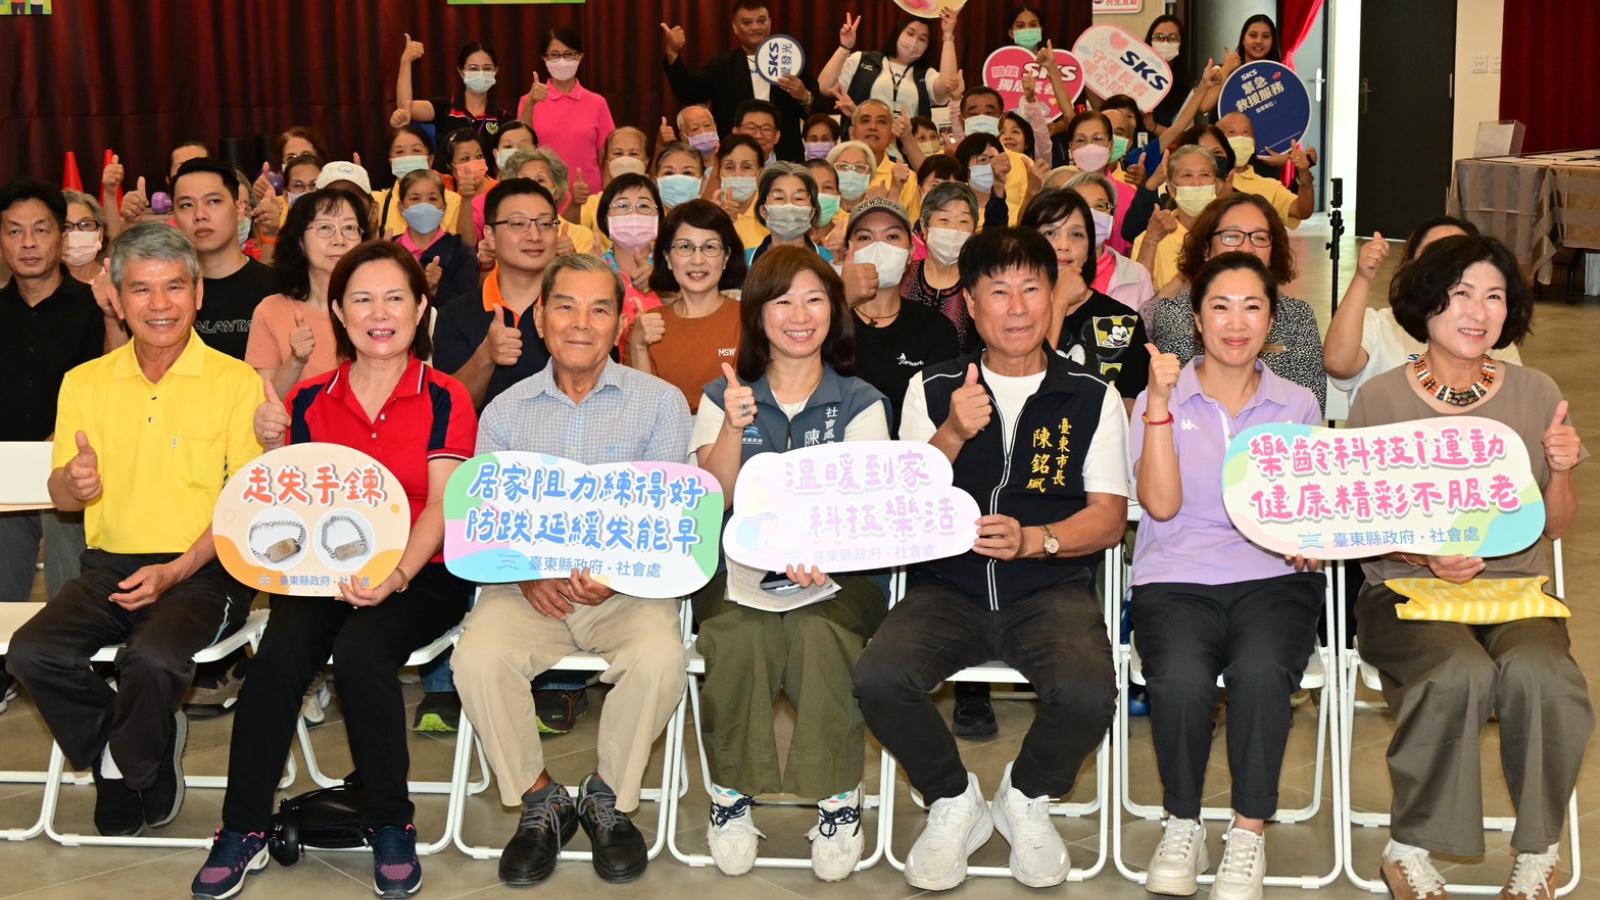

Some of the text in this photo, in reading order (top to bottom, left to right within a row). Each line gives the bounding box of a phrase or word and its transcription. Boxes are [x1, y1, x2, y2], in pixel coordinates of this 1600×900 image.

[768, 42, 779, 77] SKS
[1120, 50, 1169, 91] SKS
[1241, 68, 1258, 81] SKS
[1235, 81, 1285, 113] 救援服務
[1241, 76, 1268, 96] 緊急
[823, 406, 839, 444] 社會處
[783, 448, 930, 492] 溫暖到家
[1052, 417, 1073, 486] 臺東市長
[1250, 428, 1505, 477] 樂齡科技i運動
[242, 465, 388, 506] 走失手鍊
[469, 463, 706, 510] 居家阻力練得好
[1250, 474, 1521, 519] 健康精彩不服老
[465, 509, 701, 555] 防跌延緩失能早
[809, 495, 957, 539] 科技樂活
